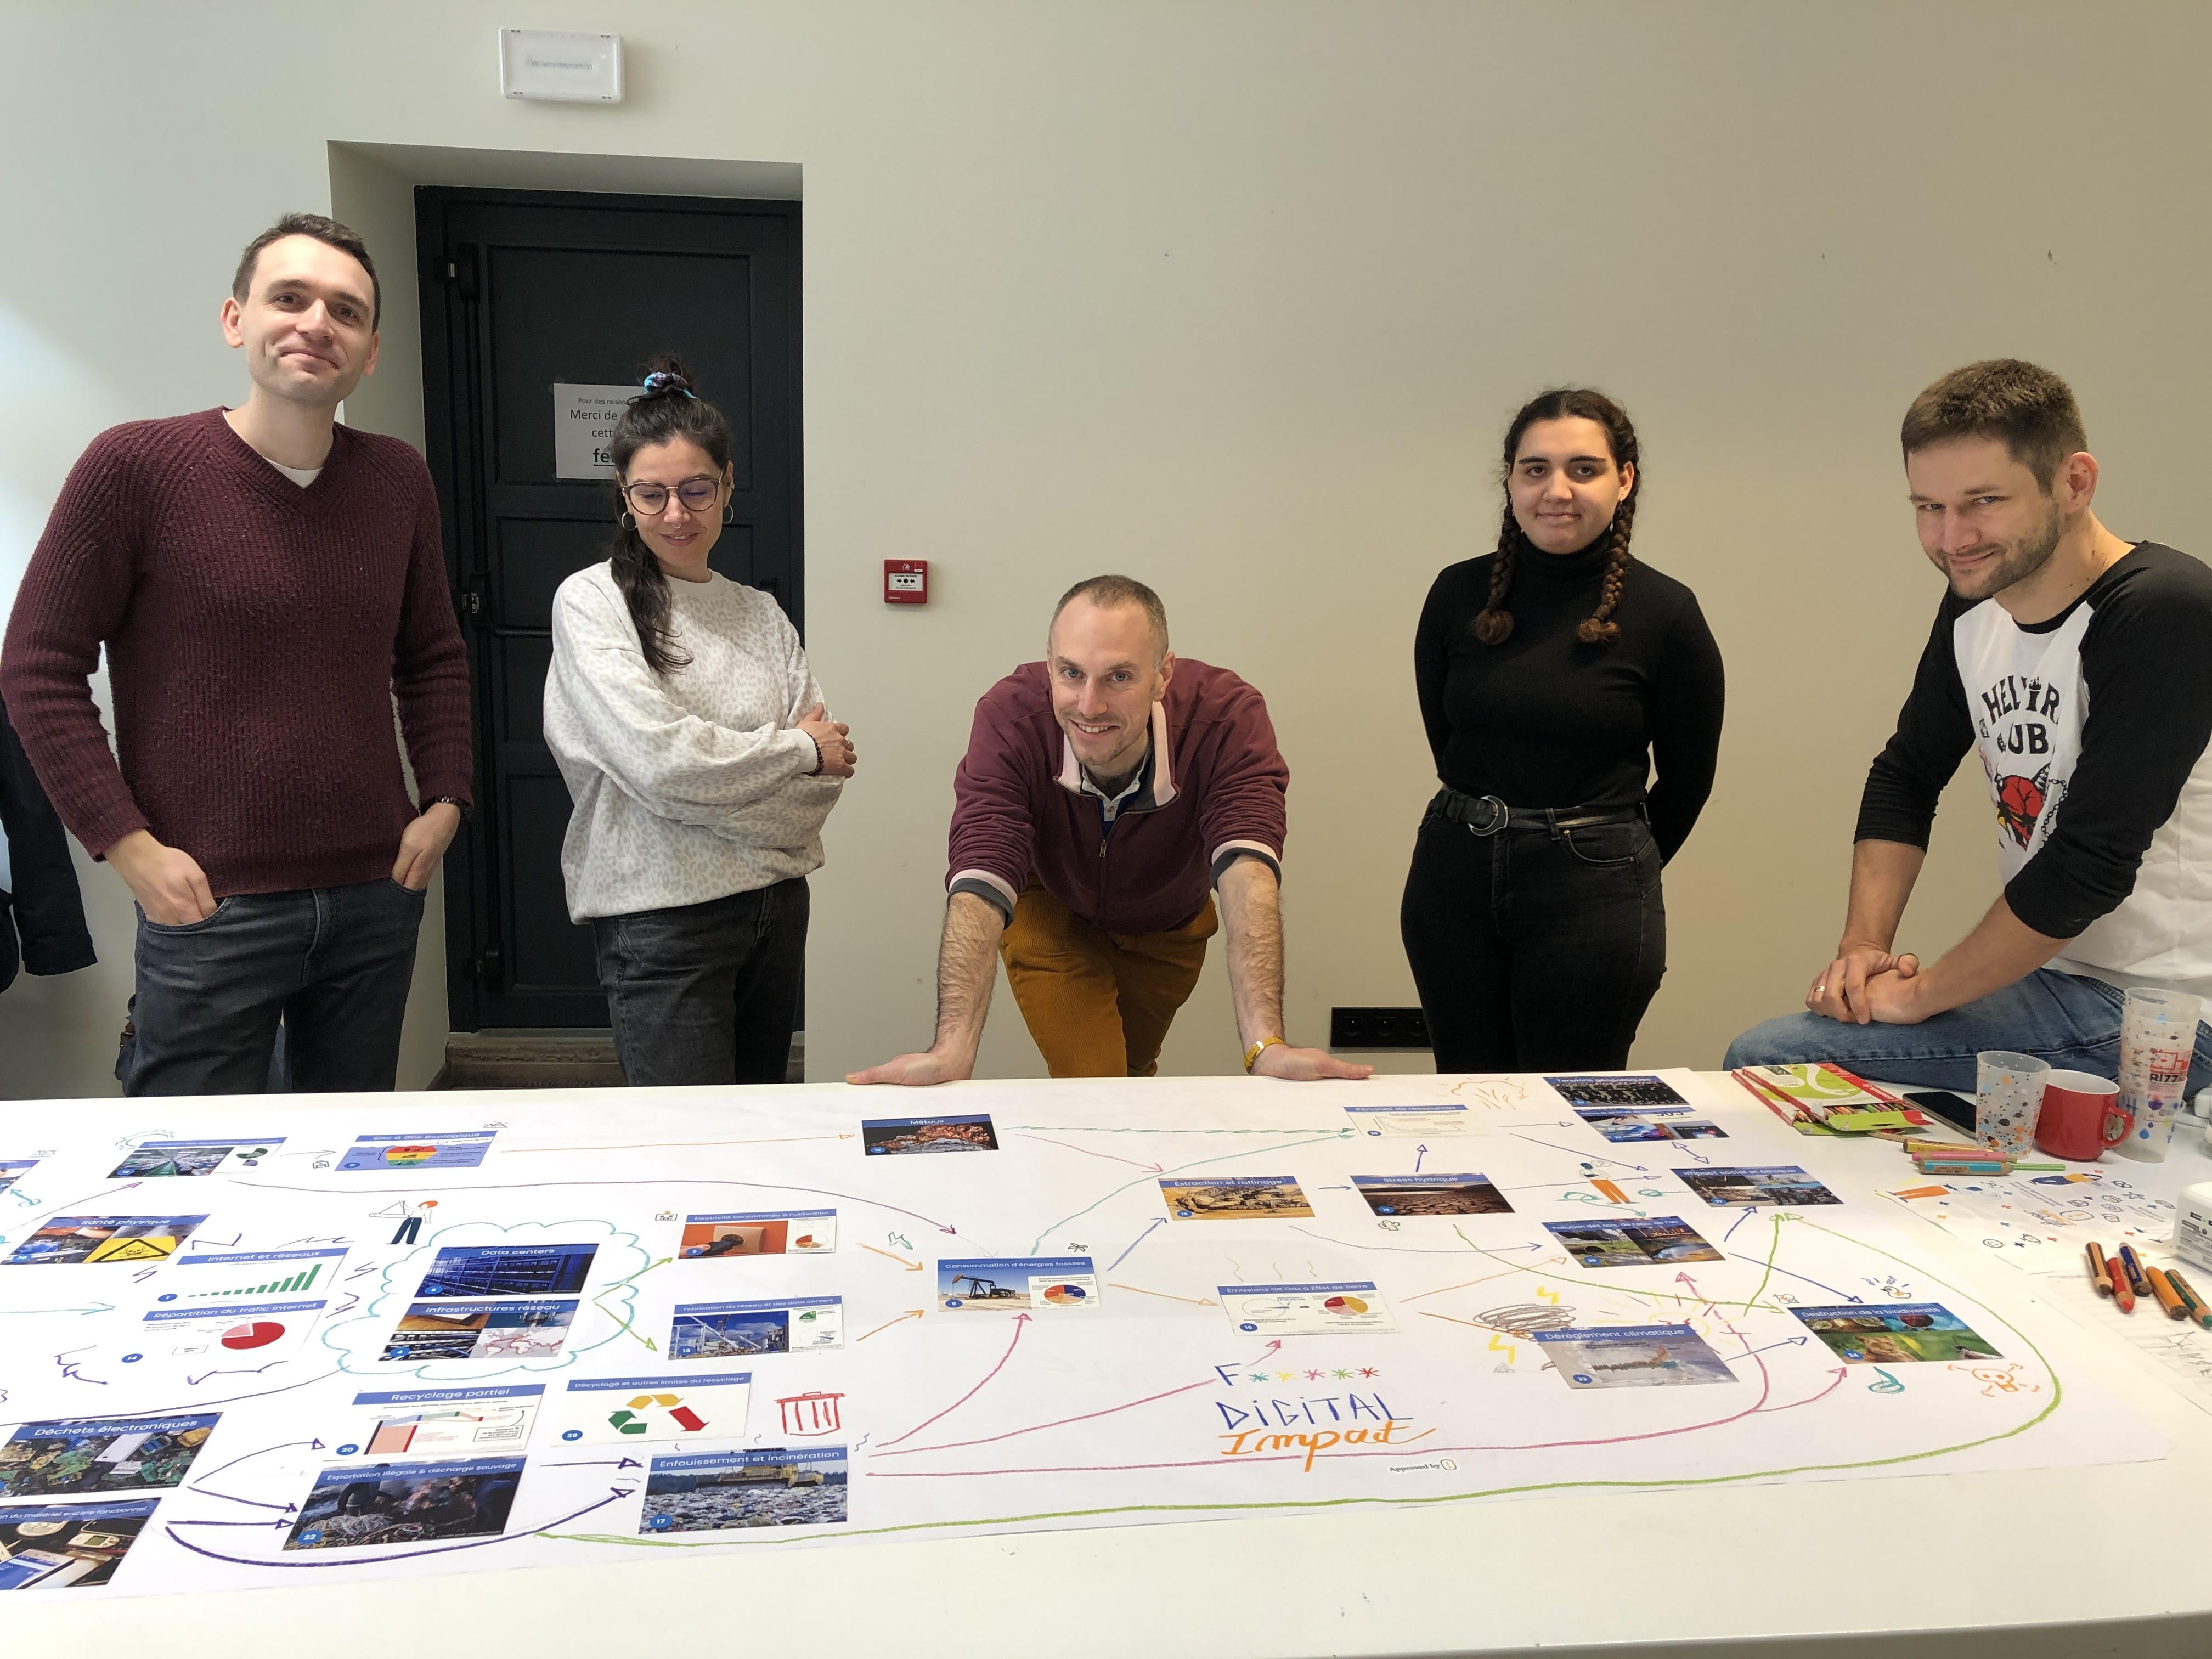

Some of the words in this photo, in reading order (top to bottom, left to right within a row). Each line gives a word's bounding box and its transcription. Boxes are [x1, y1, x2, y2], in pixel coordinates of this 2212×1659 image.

[570, 409, 601, 420] Merci
[605, 410, 618, 420] de
[592, 429, 613, 438] cett
[592, 448, 615, 463] fe
[116, 1218, 170, 1227] physique
[153, 1310, 218, 1319] Répartition
[239, 1305, 269, 1313] trafic
[426, 1305, 515, 1313] Infrastructures
[517, 1303, 560, 1311] réseau
[1885, 1307, 1941, 1315] biodiversité
[1544, 1330, 1621, 1340] Dérèglement
[1623, 1329, 1685, 1339] climatique
[575, 1381, 620, 1389] Décyclage
[703, 1375, 744, 1385] recyclage
[391, 1391, 462, 1401] Recyclage
[465, 1388, 510, 1398] partiel
[34, 1426, 94, 1436] Déchets
[97, 1419, 199, 1434] électroniques
[659, 1456, 749, 1468] Enfouissement
[768, 1451, 839, 1462] incinération
[326, 1471, 381, 1481] Exportation
[382, 1468, 417, 1477] illégale
[428, 1465, 474, 1475] décharge
[476, 1462, 517, 1471] sauvage
[1390, 1464, 1429, 1472] Approved
[96, 1505, 148, 1515] fonctionnel
